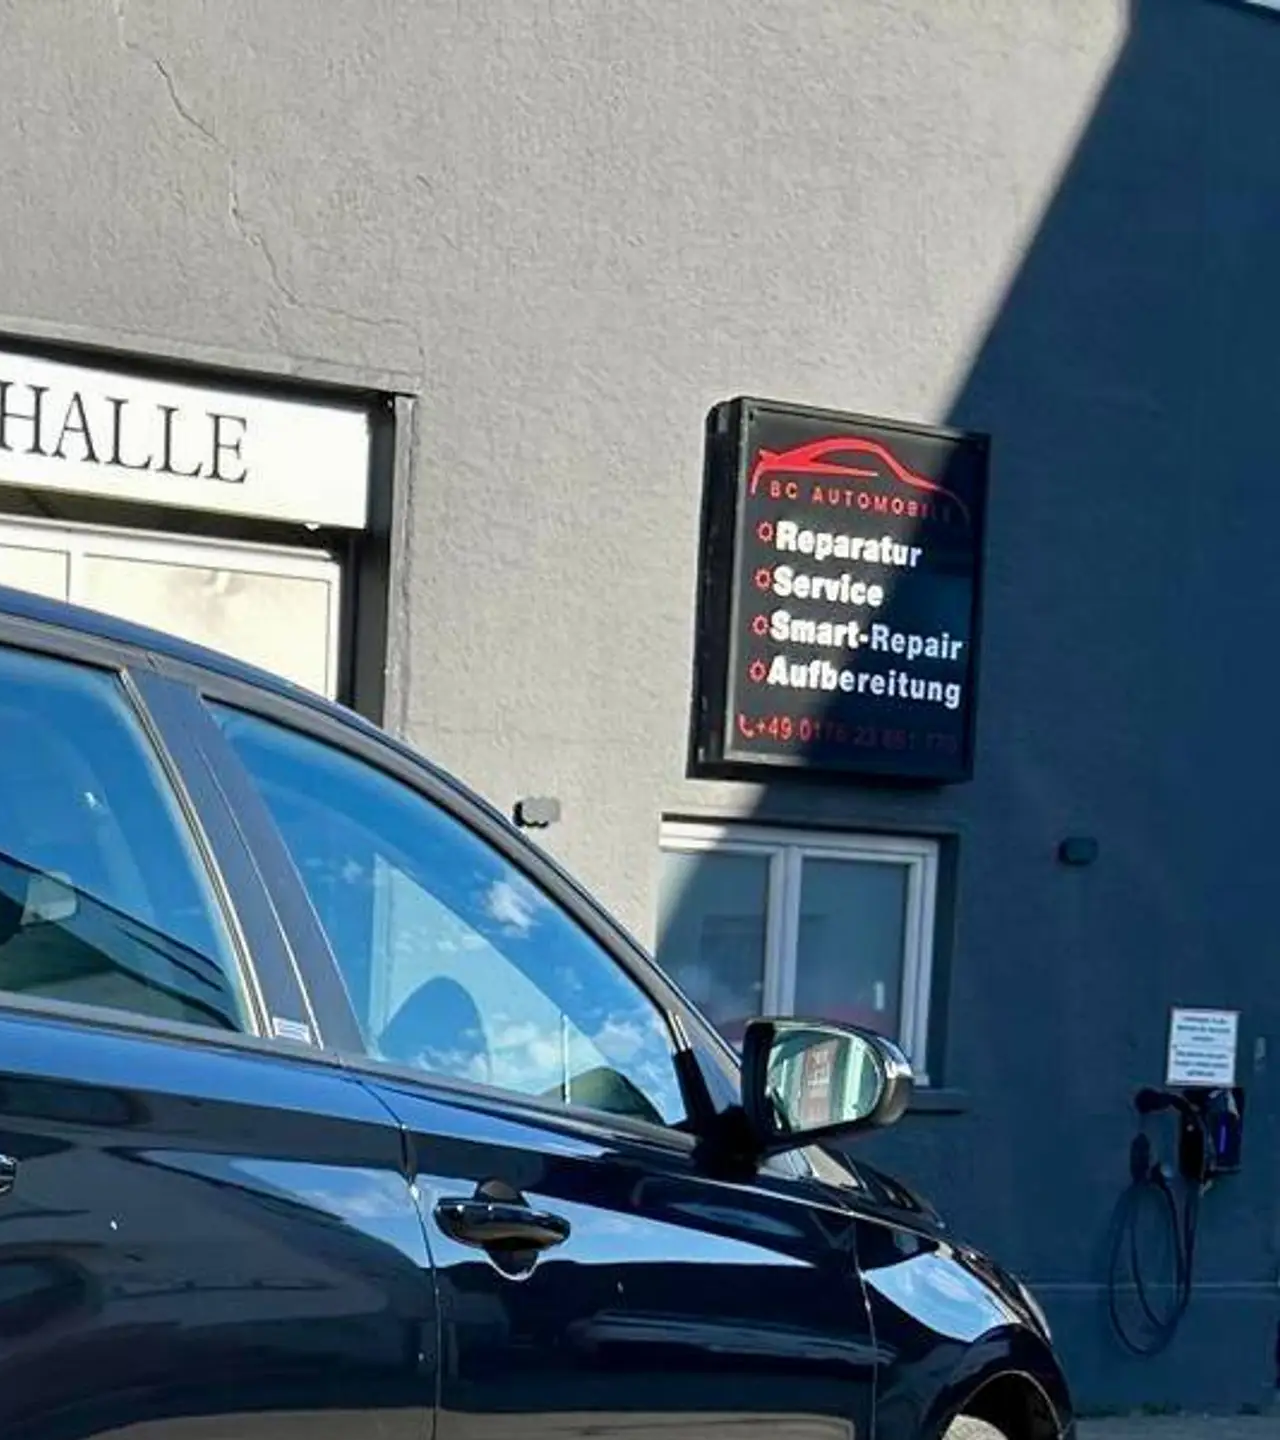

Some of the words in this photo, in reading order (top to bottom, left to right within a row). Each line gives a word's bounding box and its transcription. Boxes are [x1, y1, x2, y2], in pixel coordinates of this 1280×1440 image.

[770, 480, 797, 499] BC
[812, 486, 953, 523] AUTOMOBIL
[776, 520, 922, 566] Reparatur
[772, 567, 884, 608] Service
[769, 609, 964, 660] Smart-Repair
[767, 657, 960, 708] Aufbereitung
[756, 716, 792, 741] +49
